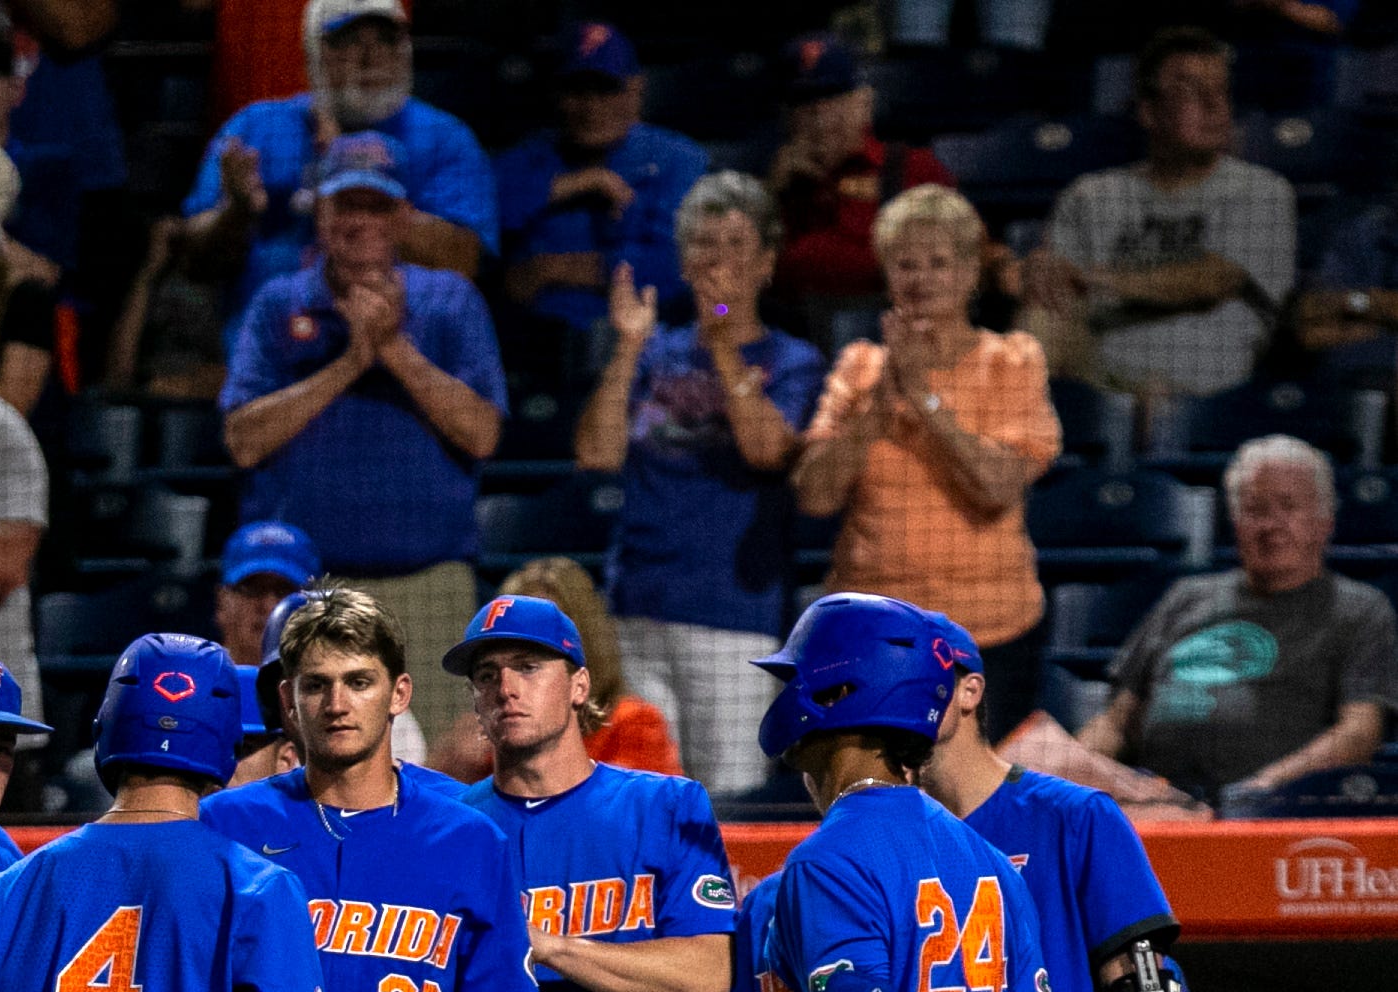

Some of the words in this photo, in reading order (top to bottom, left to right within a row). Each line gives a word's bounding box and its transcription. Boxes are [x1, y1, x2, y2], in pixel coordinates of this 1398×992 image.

[480, 598, 515, 633] F
[160, 739, 169, 751] 4
[520, 873, 656, 937] RIDA
